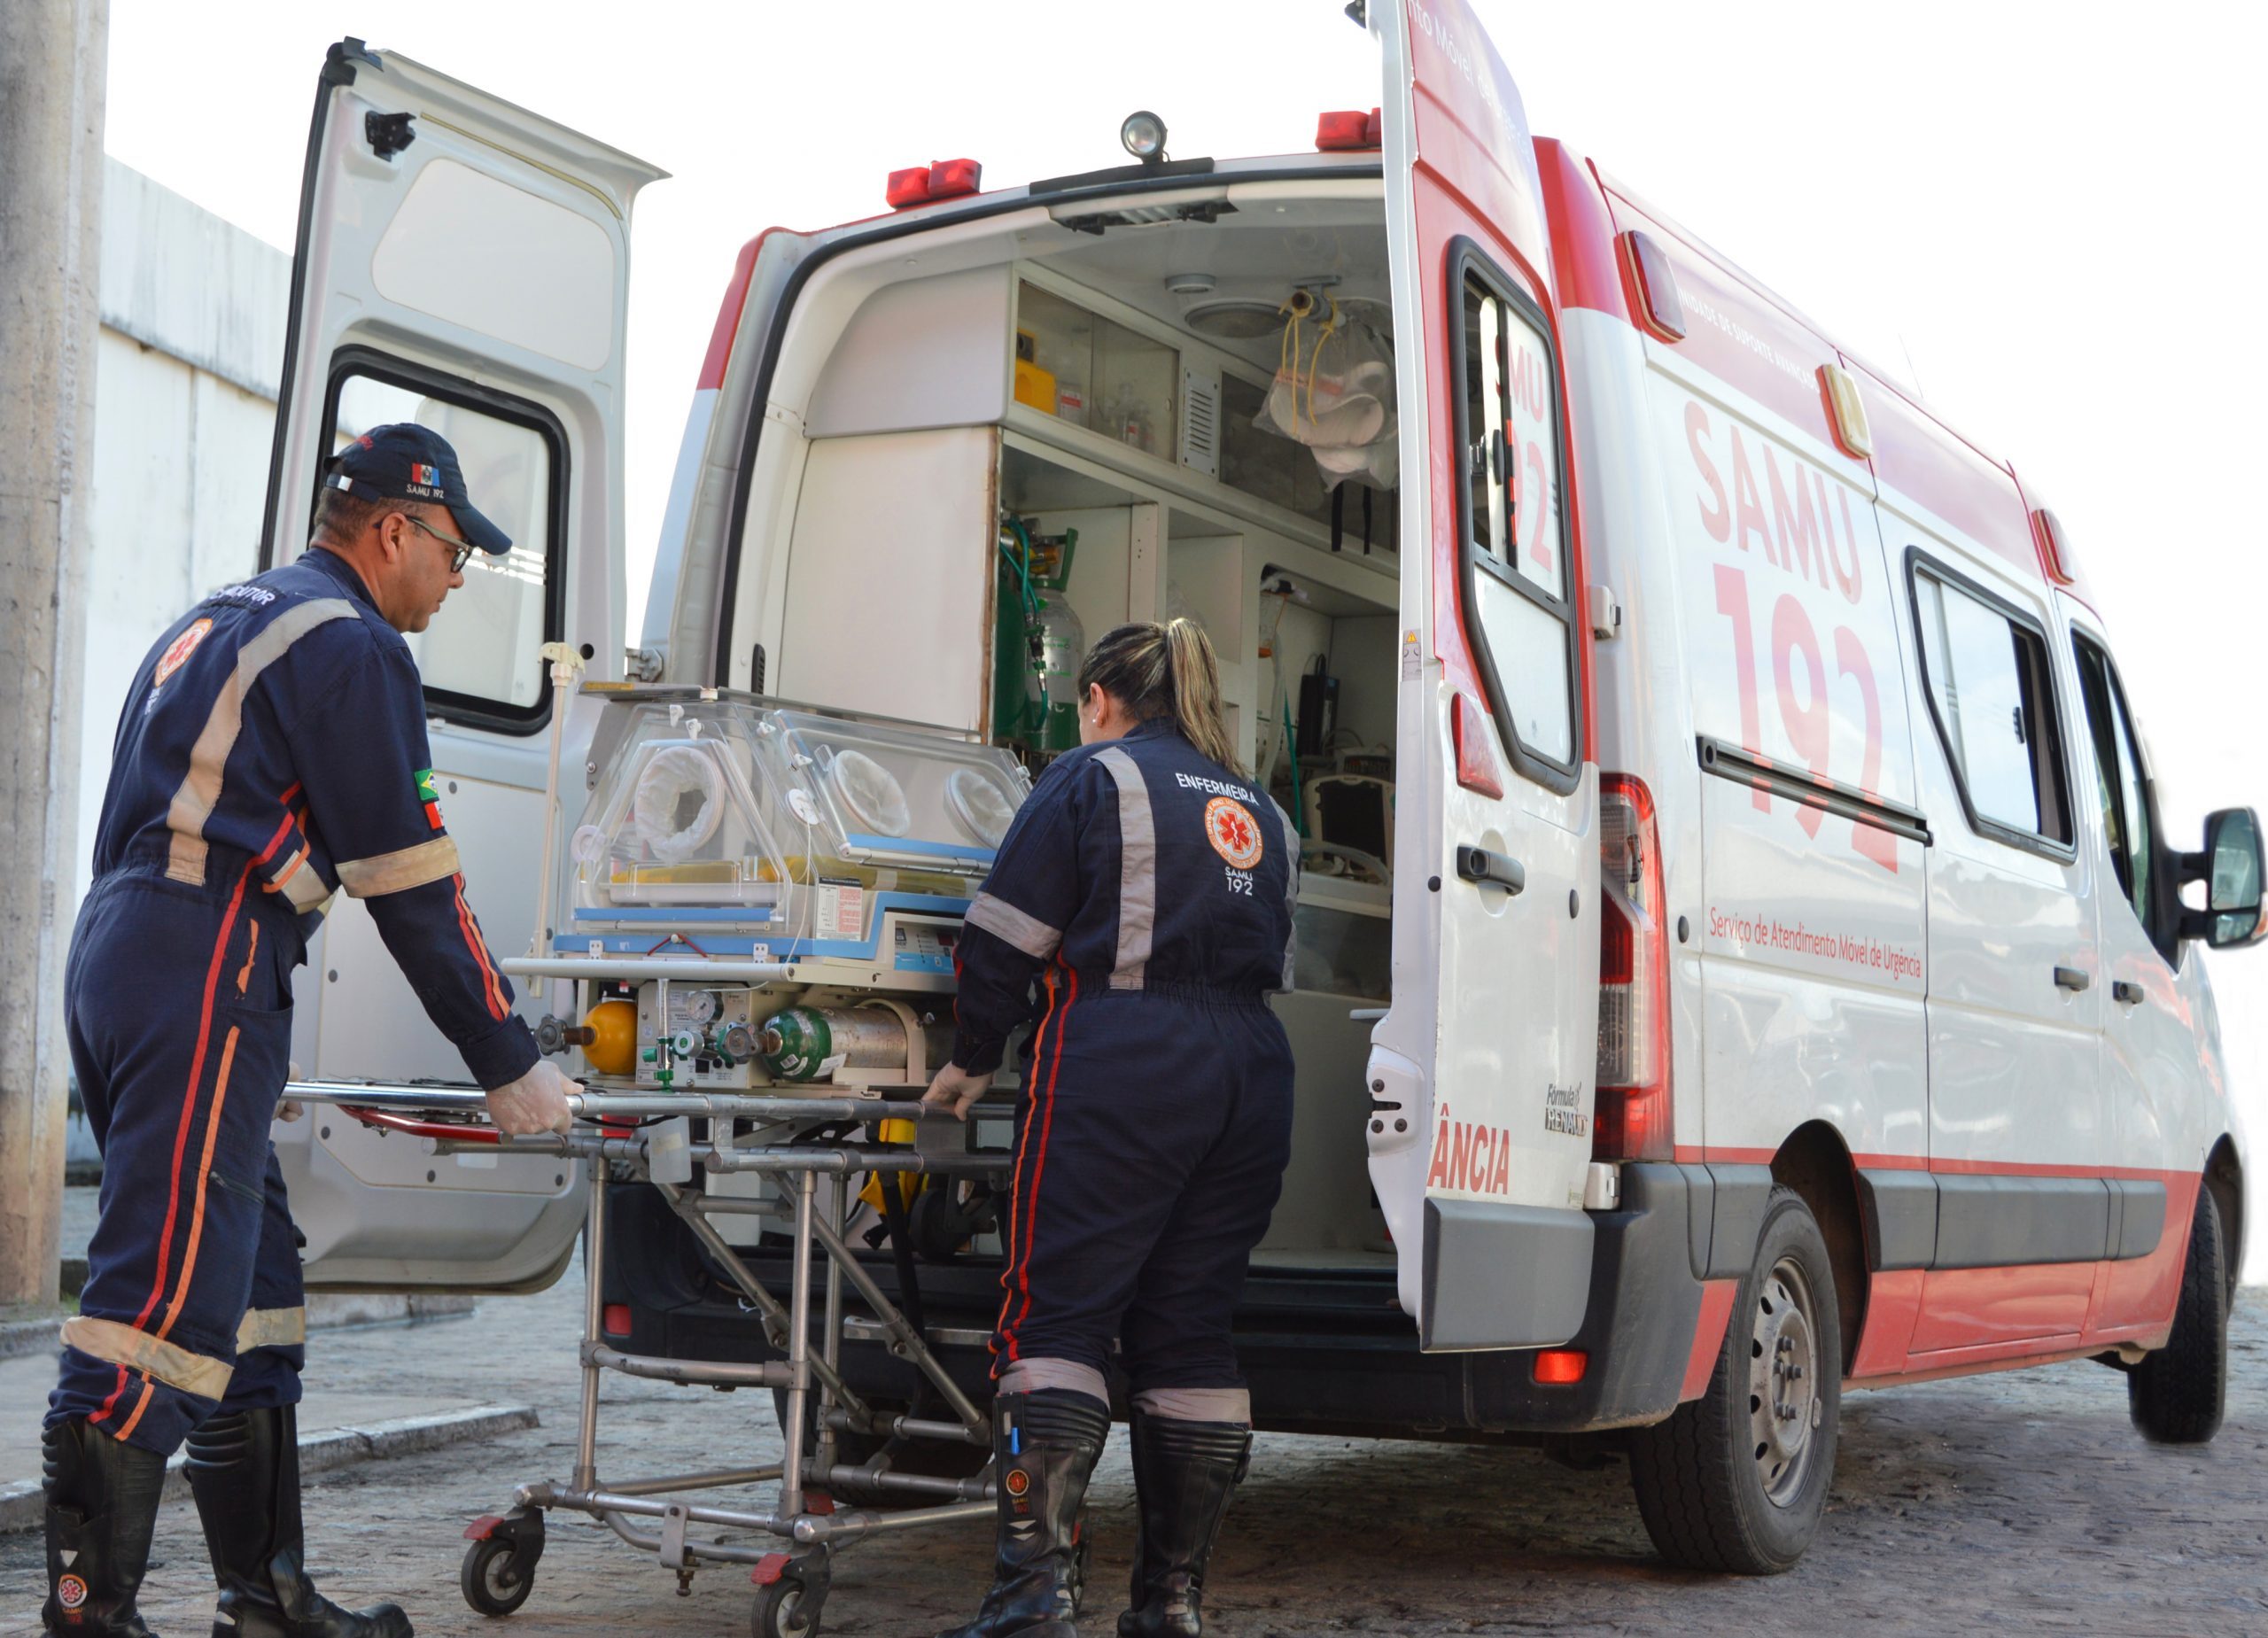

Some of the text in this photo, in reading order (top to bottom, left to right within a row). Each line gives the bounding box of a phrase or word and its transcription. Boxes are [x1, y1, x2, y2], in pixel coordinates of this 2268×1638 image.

[1434, 16, 1474, 86] Móvel
[407, 484, 444, 499] SAMU 192
[1684, 400, 1862, 604] SAMU
[1713, 563, 1898, 874] 192
[1176, 772, 1260, 805] ENFERMEIRA
[1224, 866, 1253, 881] SAMU
[1227, 877, 1253, 896] 192
[1710, 906, 1922, 981] Serviço de Atendimento Móvel de Urgência
[1427, 1102, 1510, 1195] ÂNCIA
